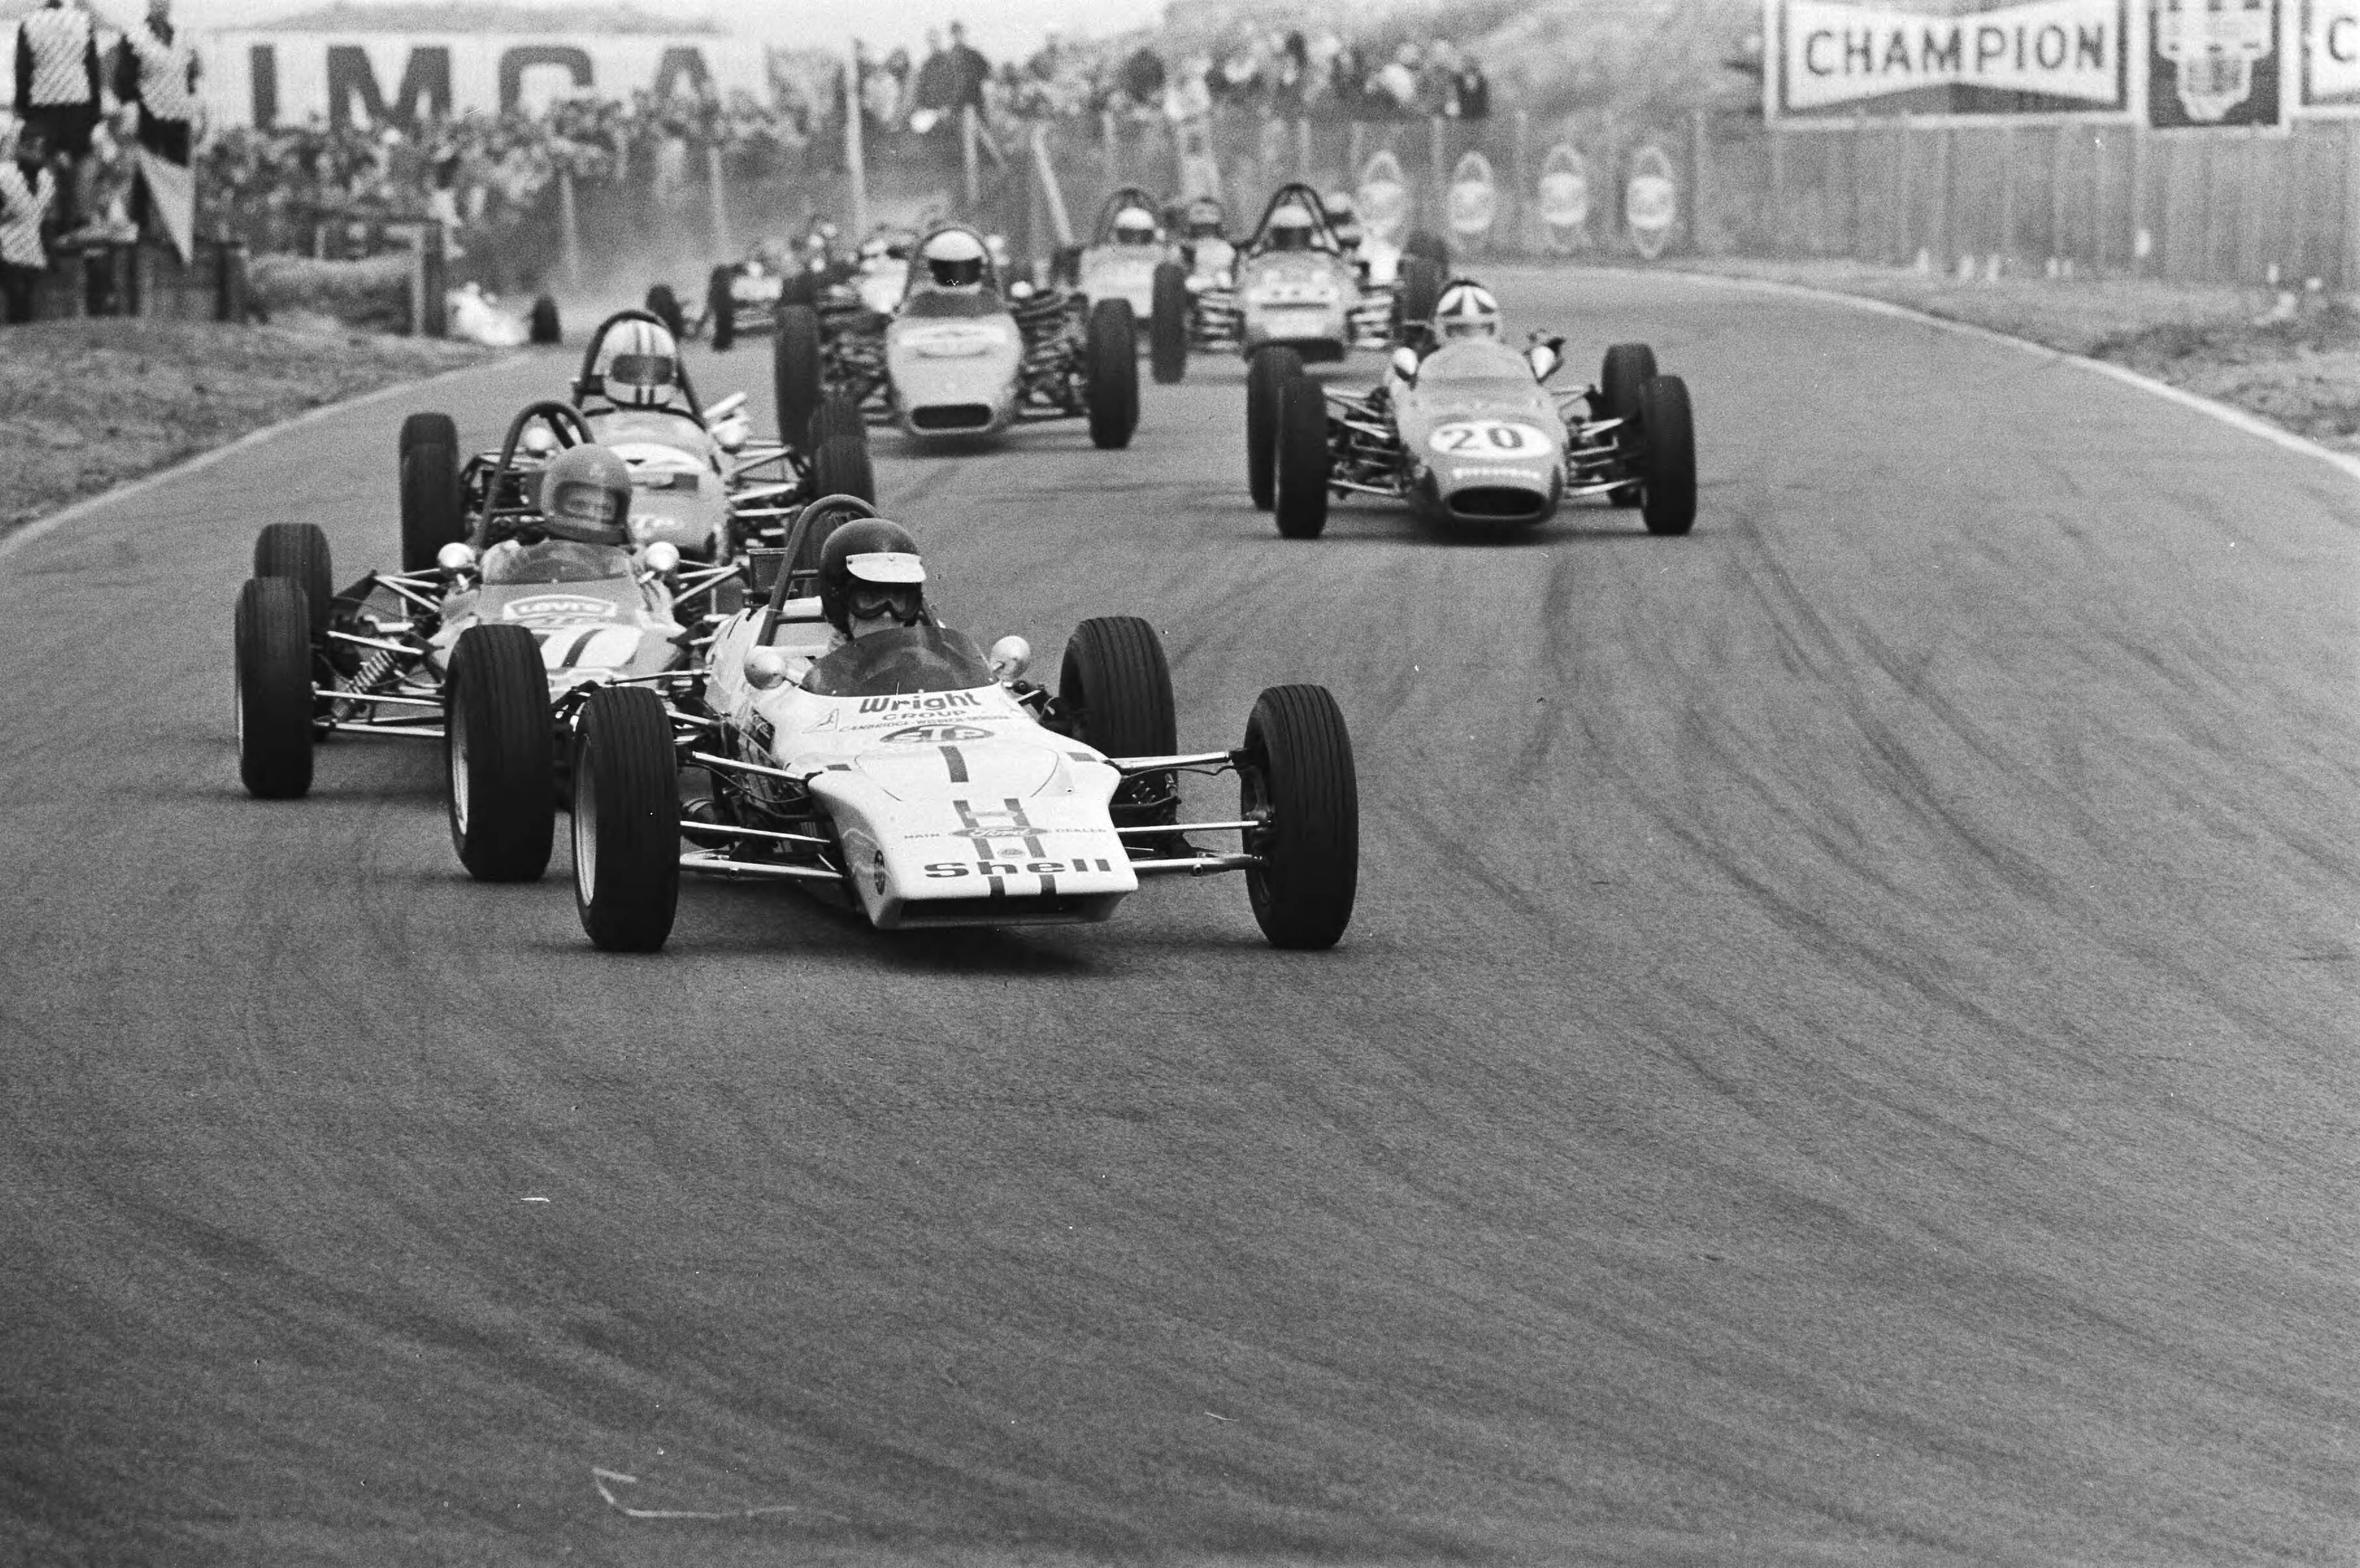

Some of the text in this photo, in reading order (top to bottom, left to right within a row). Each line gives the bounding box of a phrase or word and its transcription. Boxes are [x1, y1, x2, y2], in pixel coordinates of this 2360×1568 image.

[1805, 23, 2105, 77] CHAMPION
[1441, 428, 1523, 450] 20
[859, 692, 982, 713] Wright
[882, 710, 967, 720] GROUP
[924, 859, 1112, 878] Shell
